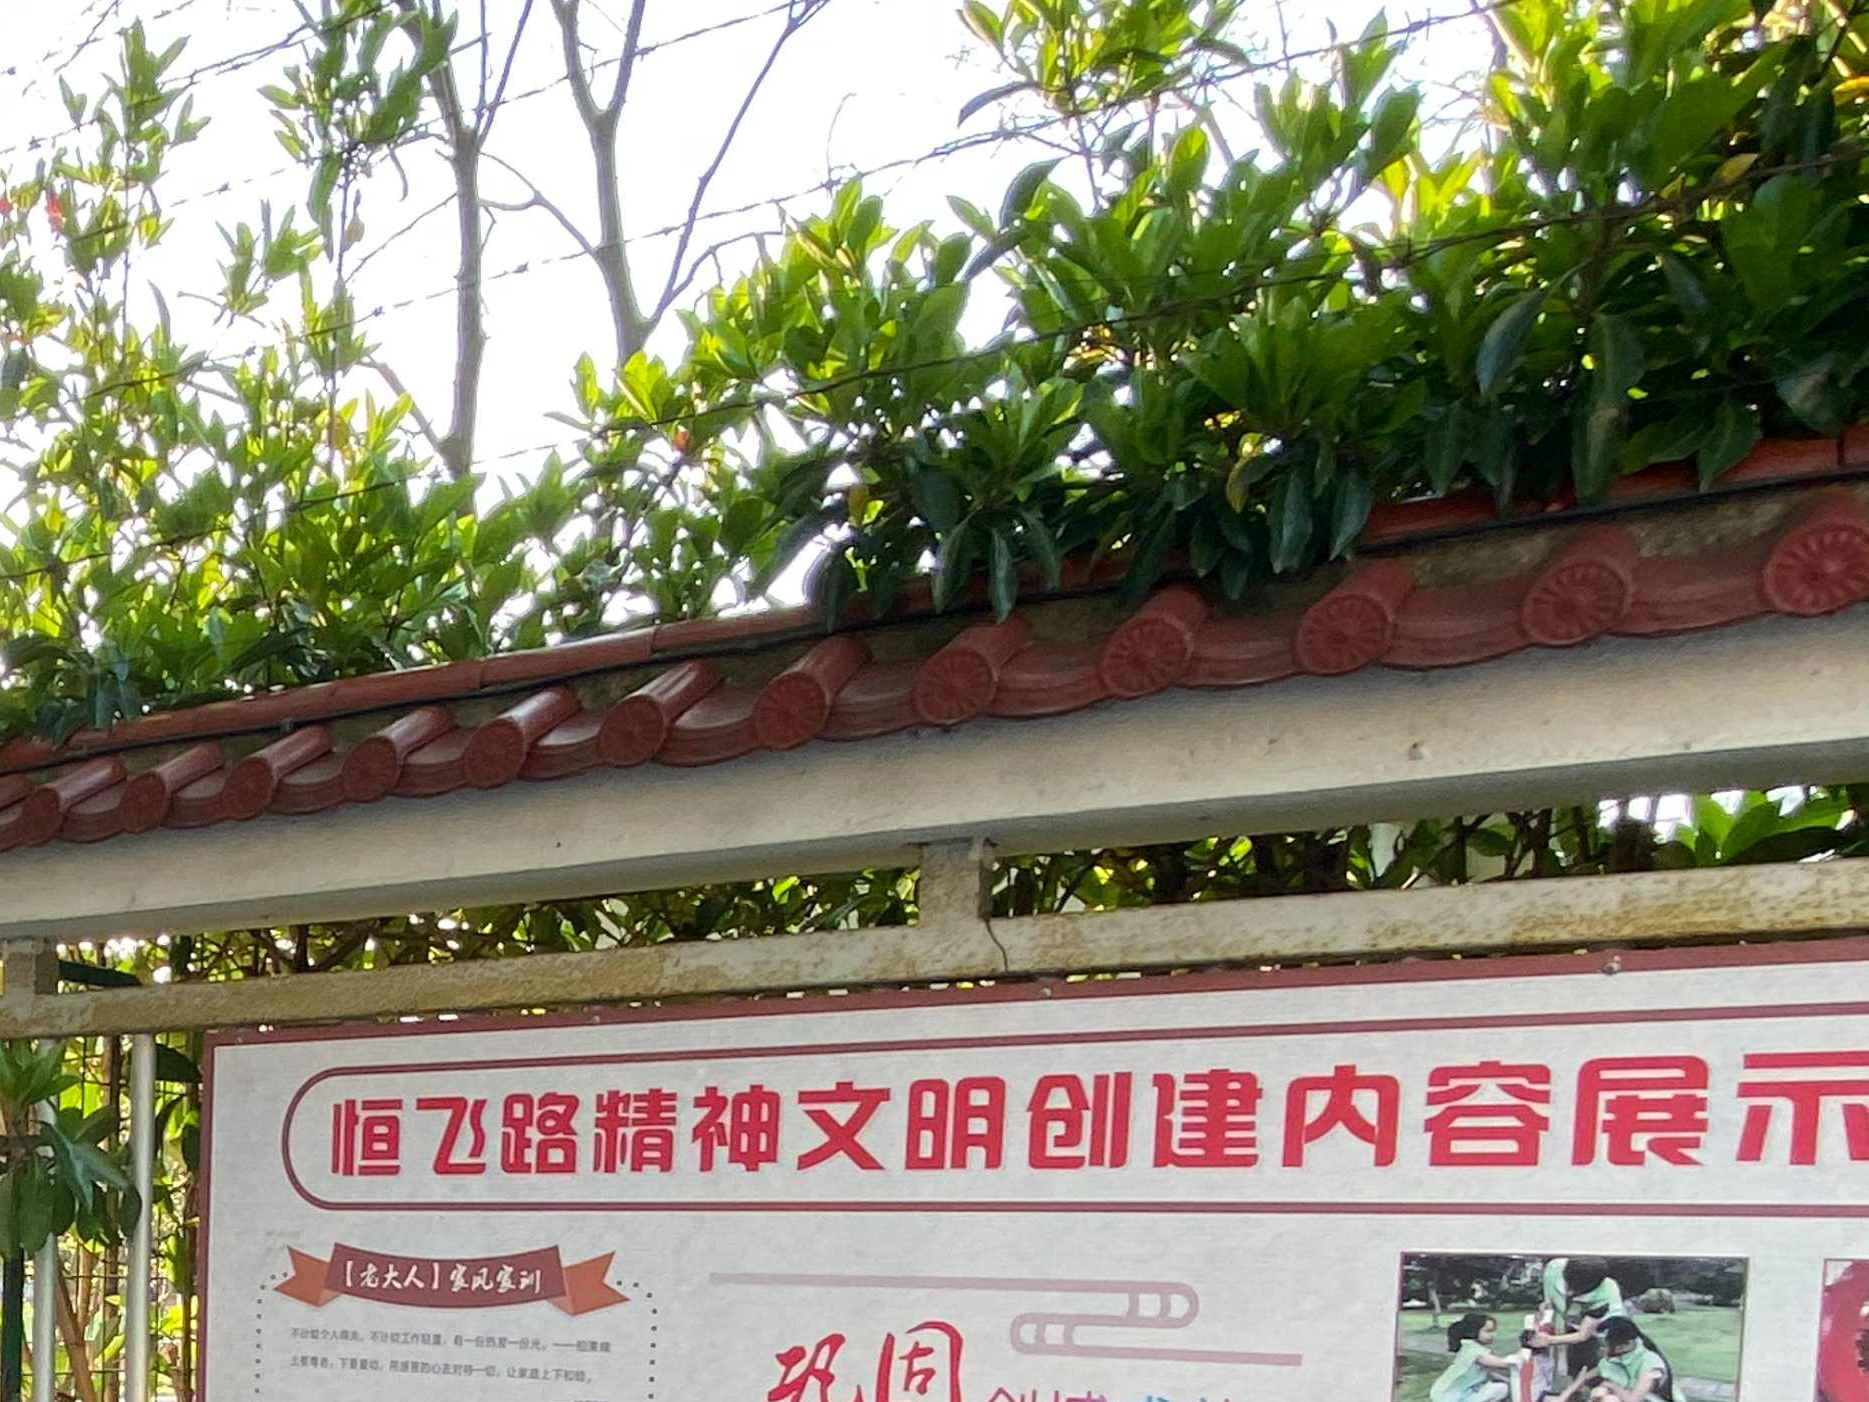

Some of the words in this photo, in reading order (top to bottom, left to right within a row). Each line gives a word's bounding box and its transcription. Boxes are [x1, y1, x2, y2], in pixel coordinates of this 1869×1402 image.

[331, 1051, 1869, 1177] 恒飞路精神文明创建内容展示
